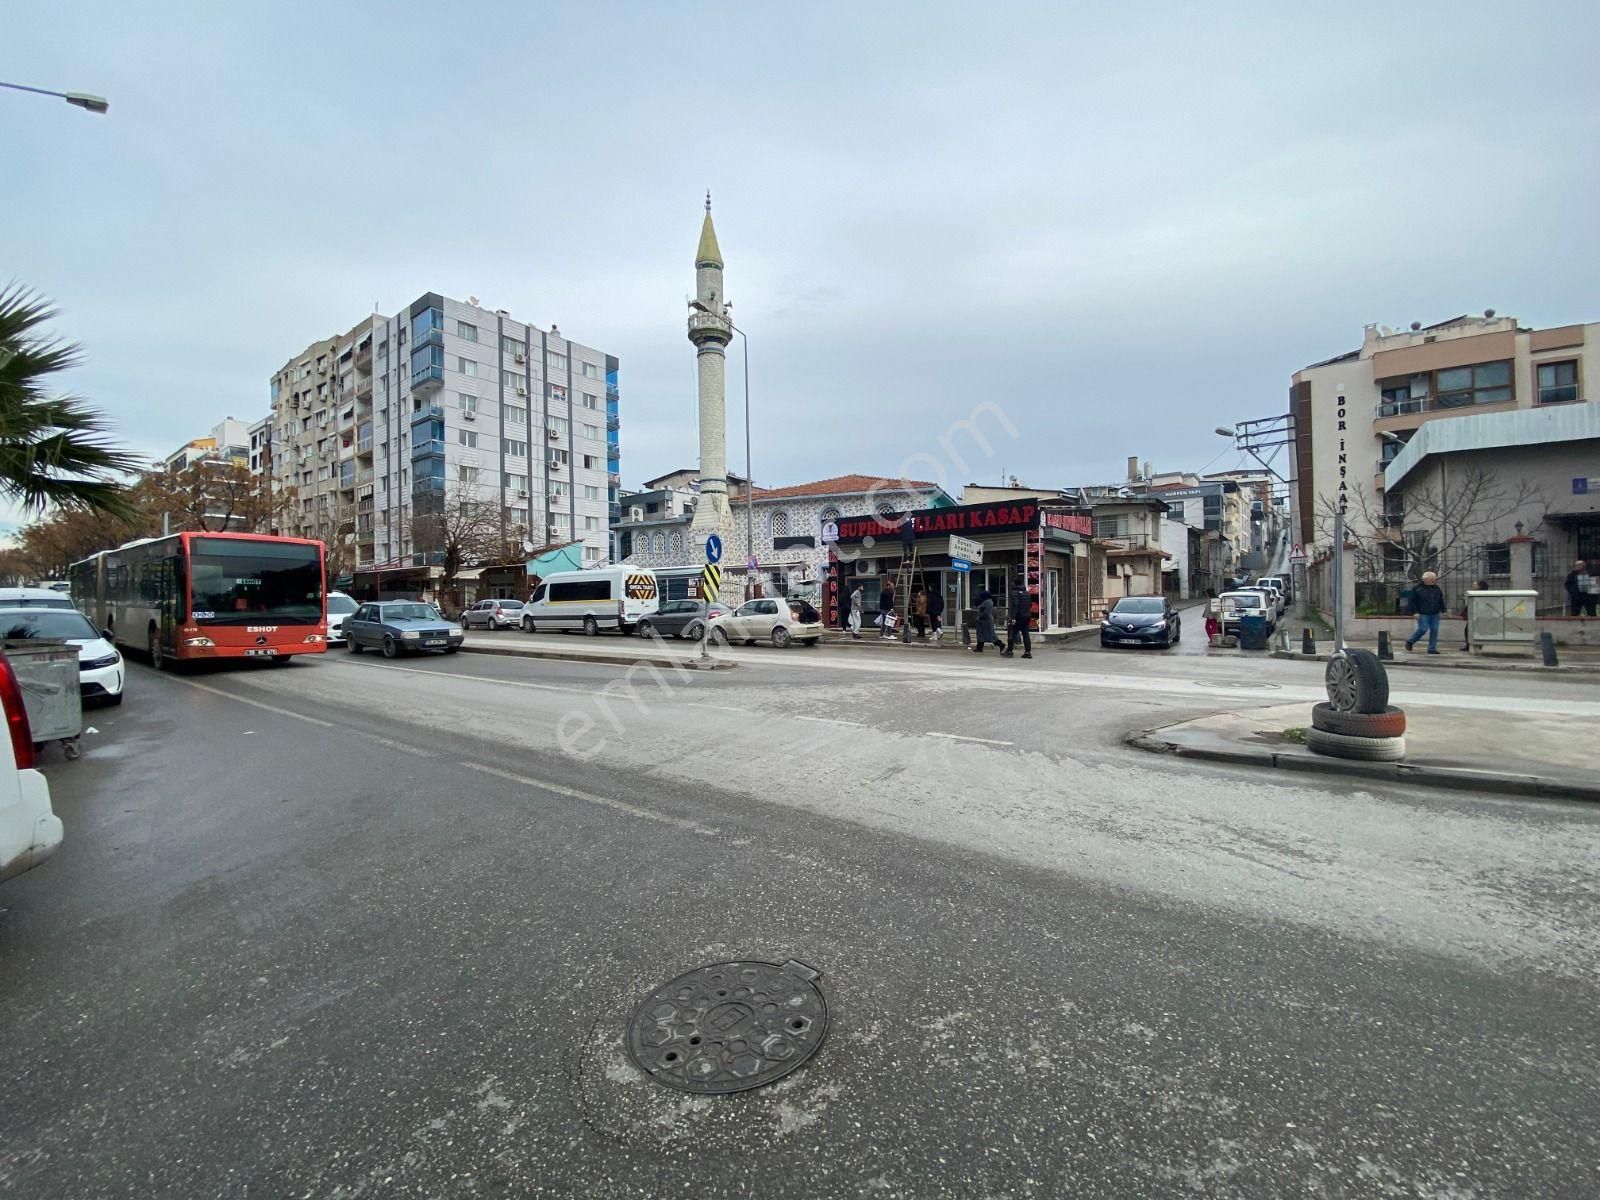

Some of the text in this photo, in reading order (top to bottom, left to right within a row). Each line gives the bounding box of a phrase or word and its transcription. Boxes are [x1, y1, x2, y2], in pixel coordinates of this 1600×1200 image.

[1337, 396, 1347, 515] BOR İNŞAAT
[969, 505, 1035, 528] KASAP
